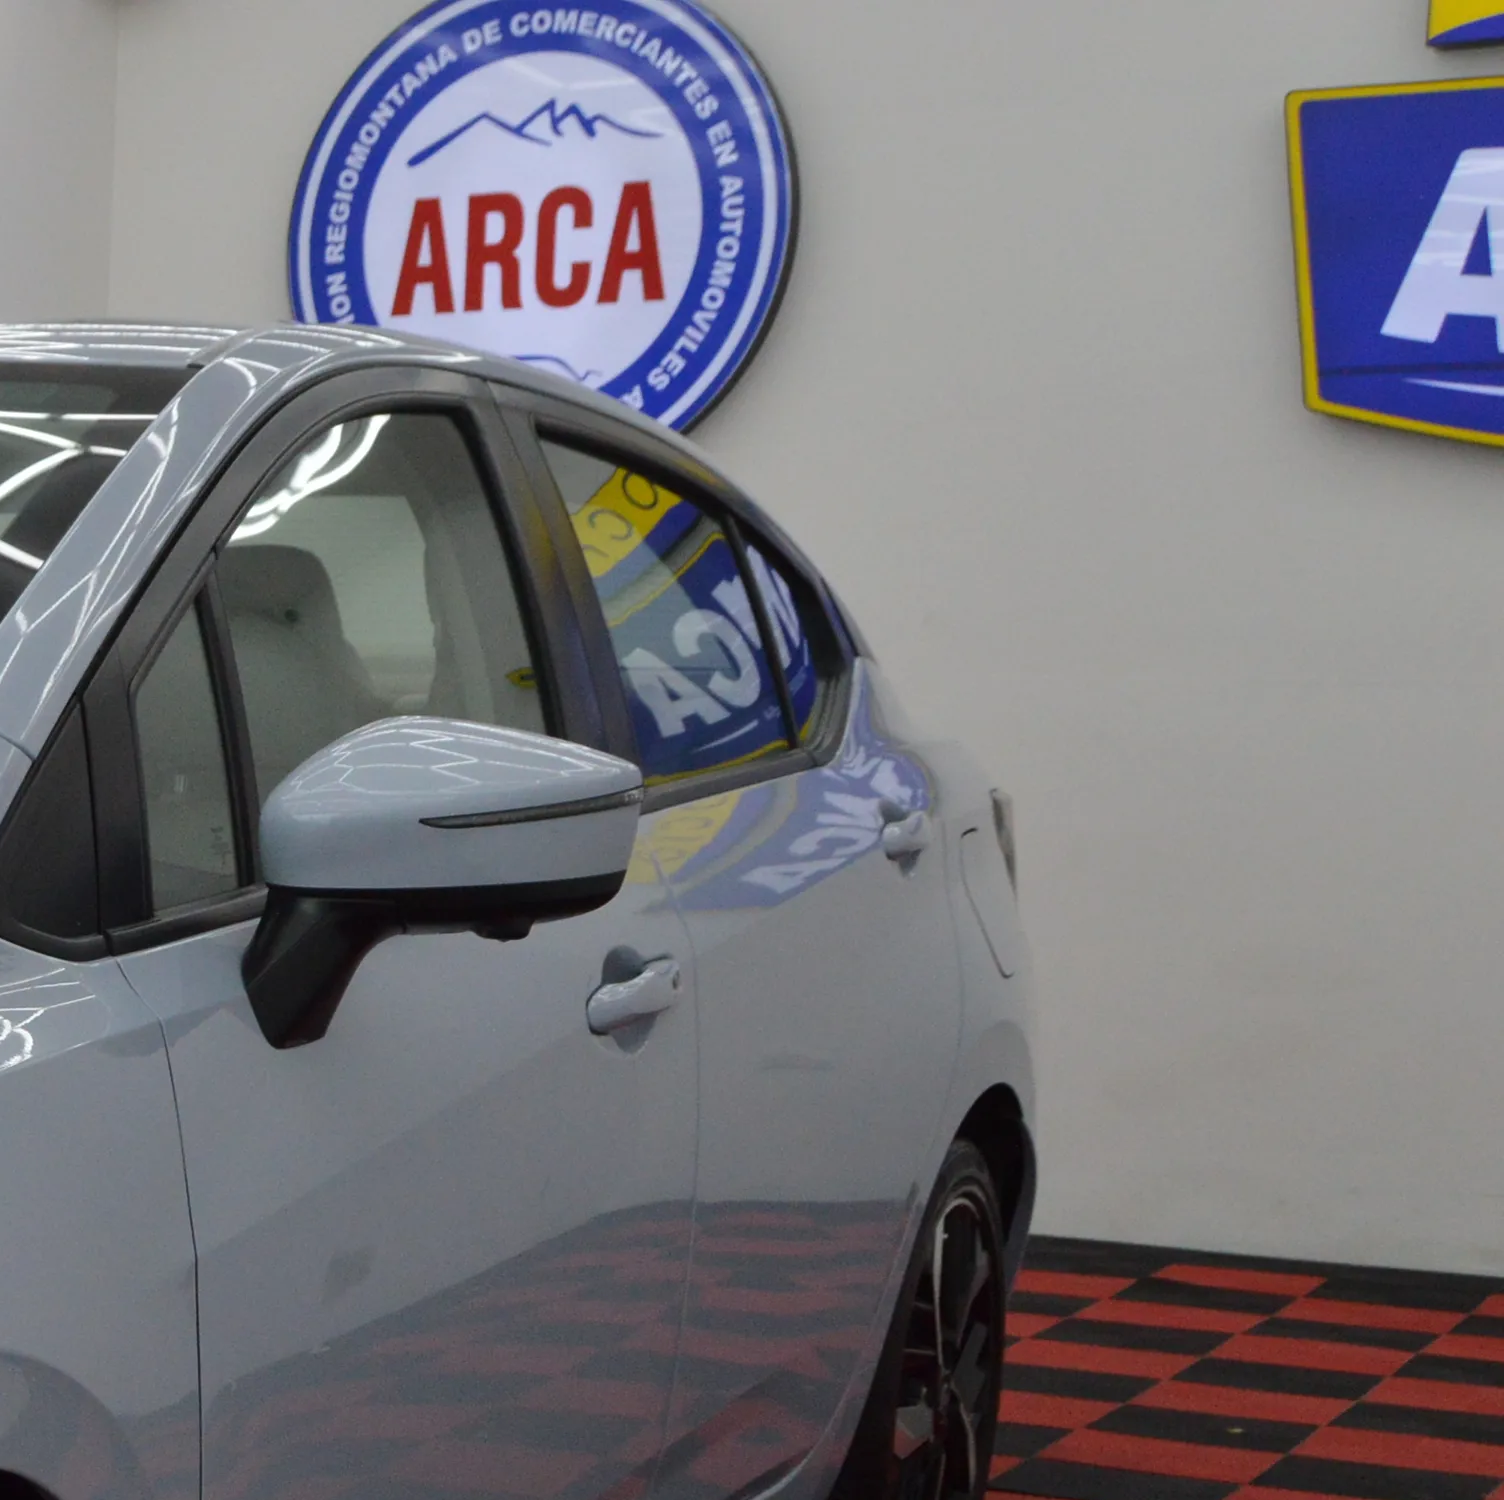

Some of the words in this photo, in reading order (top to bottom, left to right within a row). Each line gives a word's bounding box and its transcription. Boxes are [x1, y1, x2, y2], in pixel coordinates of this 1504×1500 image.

[461, 19, 503, 54] DE
[509, 8, 720, 120] COMERCIANTES
[324, 44, 457, 265] REGIOMONTANA
[705, 119, 739, 168] EN
[391, 180, 665, 317] ARCA
[647, 175, 745, 391] AUTOMOVILES
